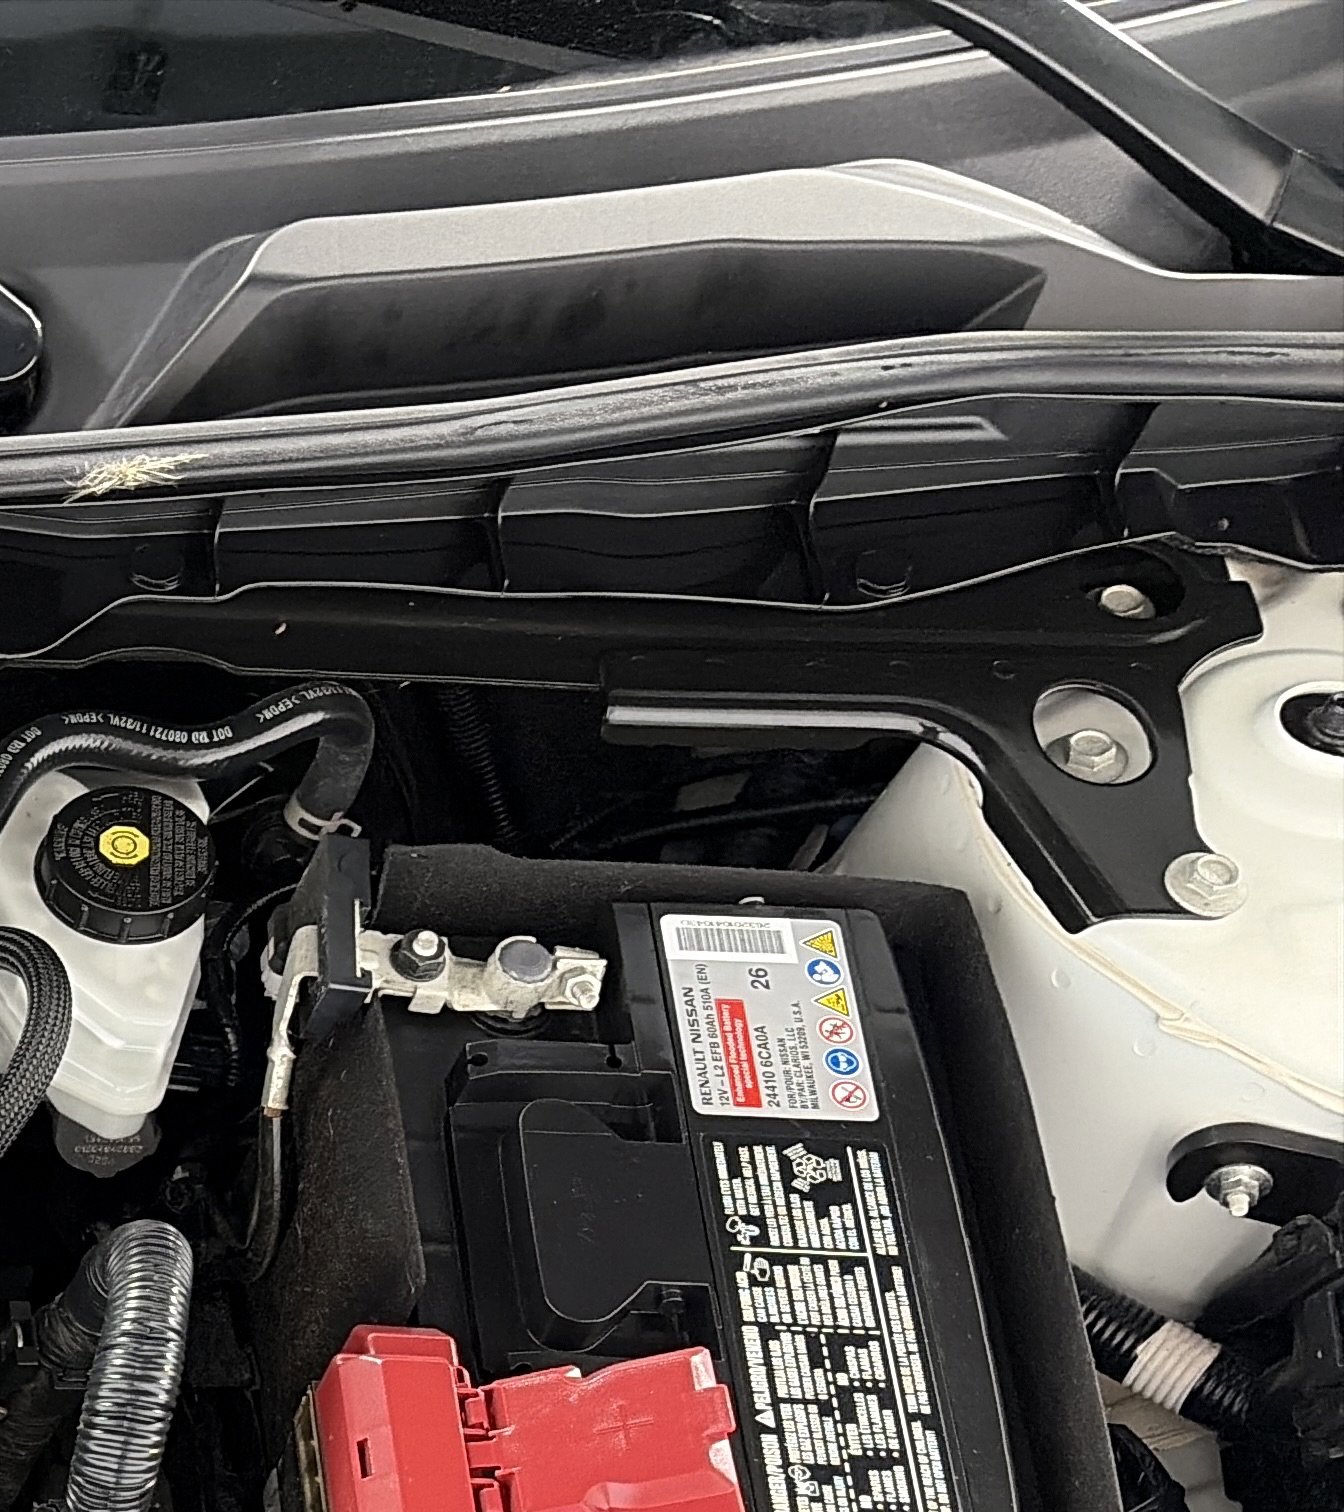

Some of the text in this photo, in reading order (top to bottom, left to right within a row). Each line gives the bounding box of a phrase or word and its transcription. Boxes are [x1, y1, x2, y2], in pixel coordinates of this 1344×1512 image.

[212, 725, 234, 742] DOT
[695, 963, 711, 985] (EN)
[748, 967, 770, 990] 26
[699, 987, 713, 1011] 510A
[704, 1013, 718, 1039] 60Ah
[784, 1027, 797, 1042] LLC
[682, 987, 713, 1106] RENAULT NISSAN
[709, 1041, 723, 1062] EFB
[721, 1004, 745, 1102] Enhanced Flooded Battery
[734, 1018, 753, 1089] special technology
[777, 1037, 790, 1066] NISSAN
[713, 1064, 726, 1078] L2
[753, 1025, 781, 1108] 24410 6CA0A
[717, 1088, 730, 1106] 12V
